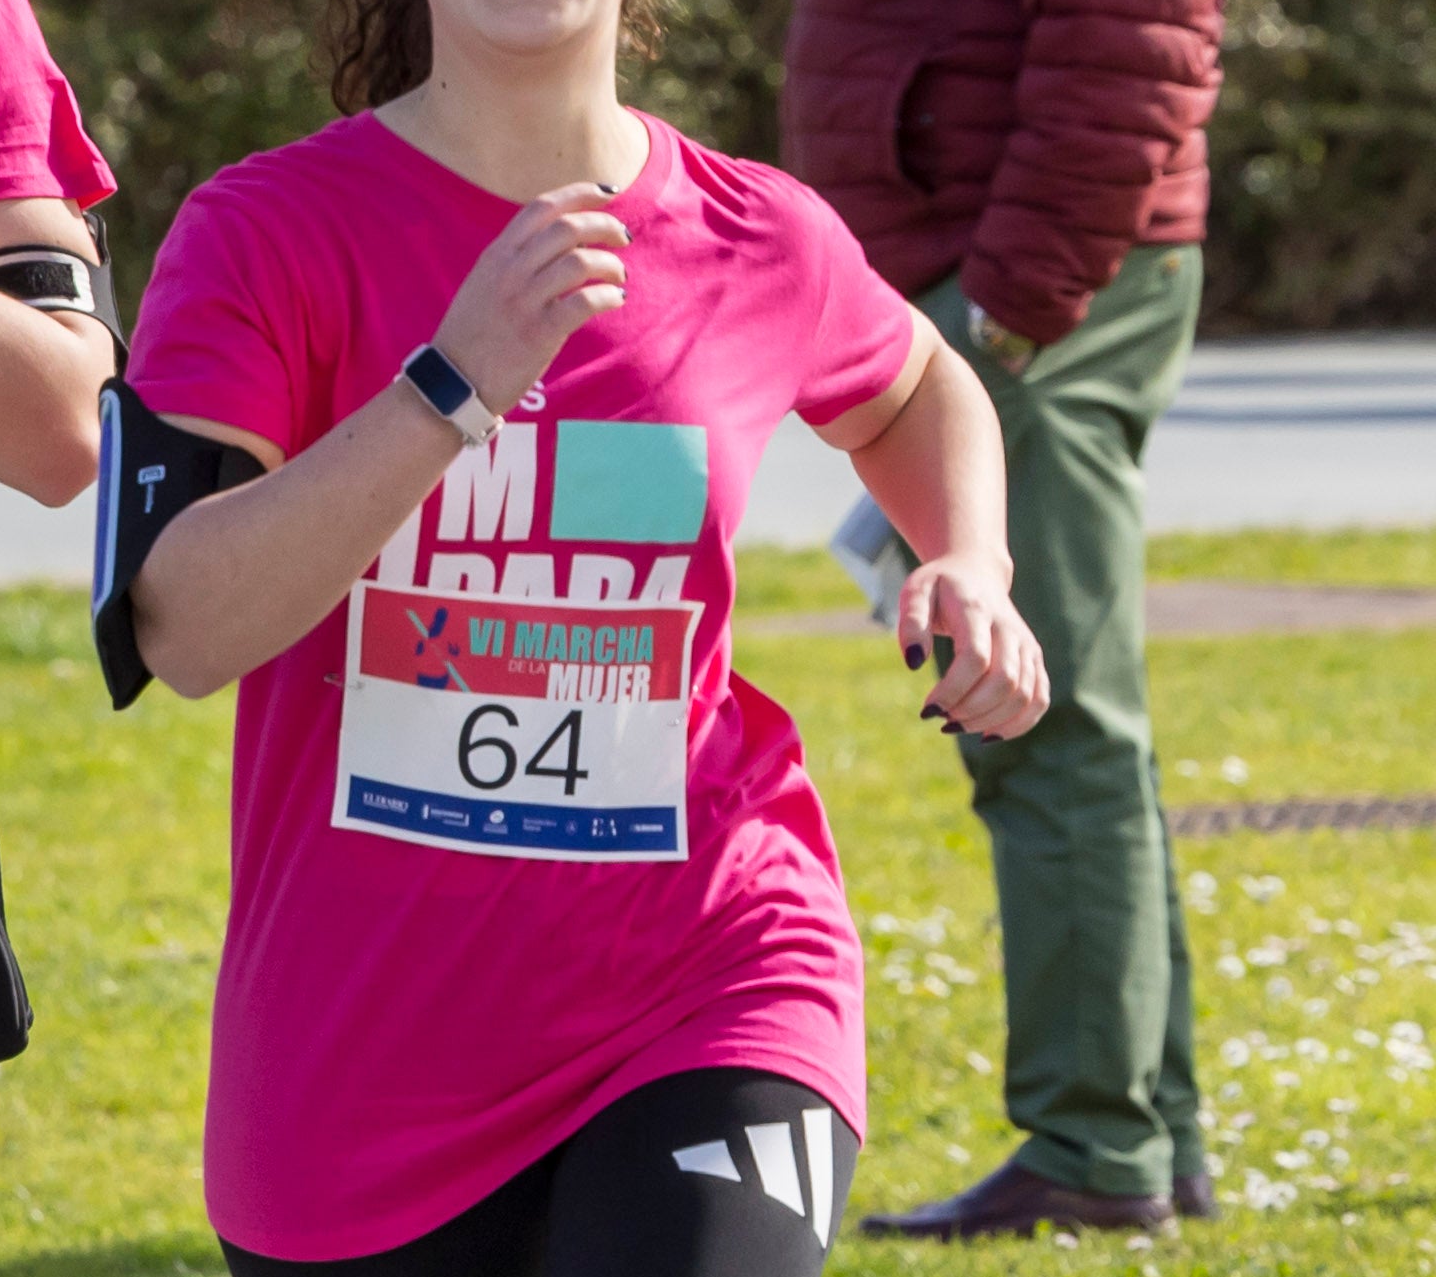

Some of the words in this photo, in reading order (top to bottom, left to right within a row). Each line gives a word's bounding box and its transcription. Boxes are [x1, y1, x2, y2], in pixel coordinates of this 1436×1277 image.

[468, 617, 506, 657] VI
[512, 621, 654, 664] MARCHA
[508, 660, 525, 674] DE
[528, 661, 546, 675] LA
[546, 663, 652, 703] MUJER
[458, 703, 589, 796] 64
